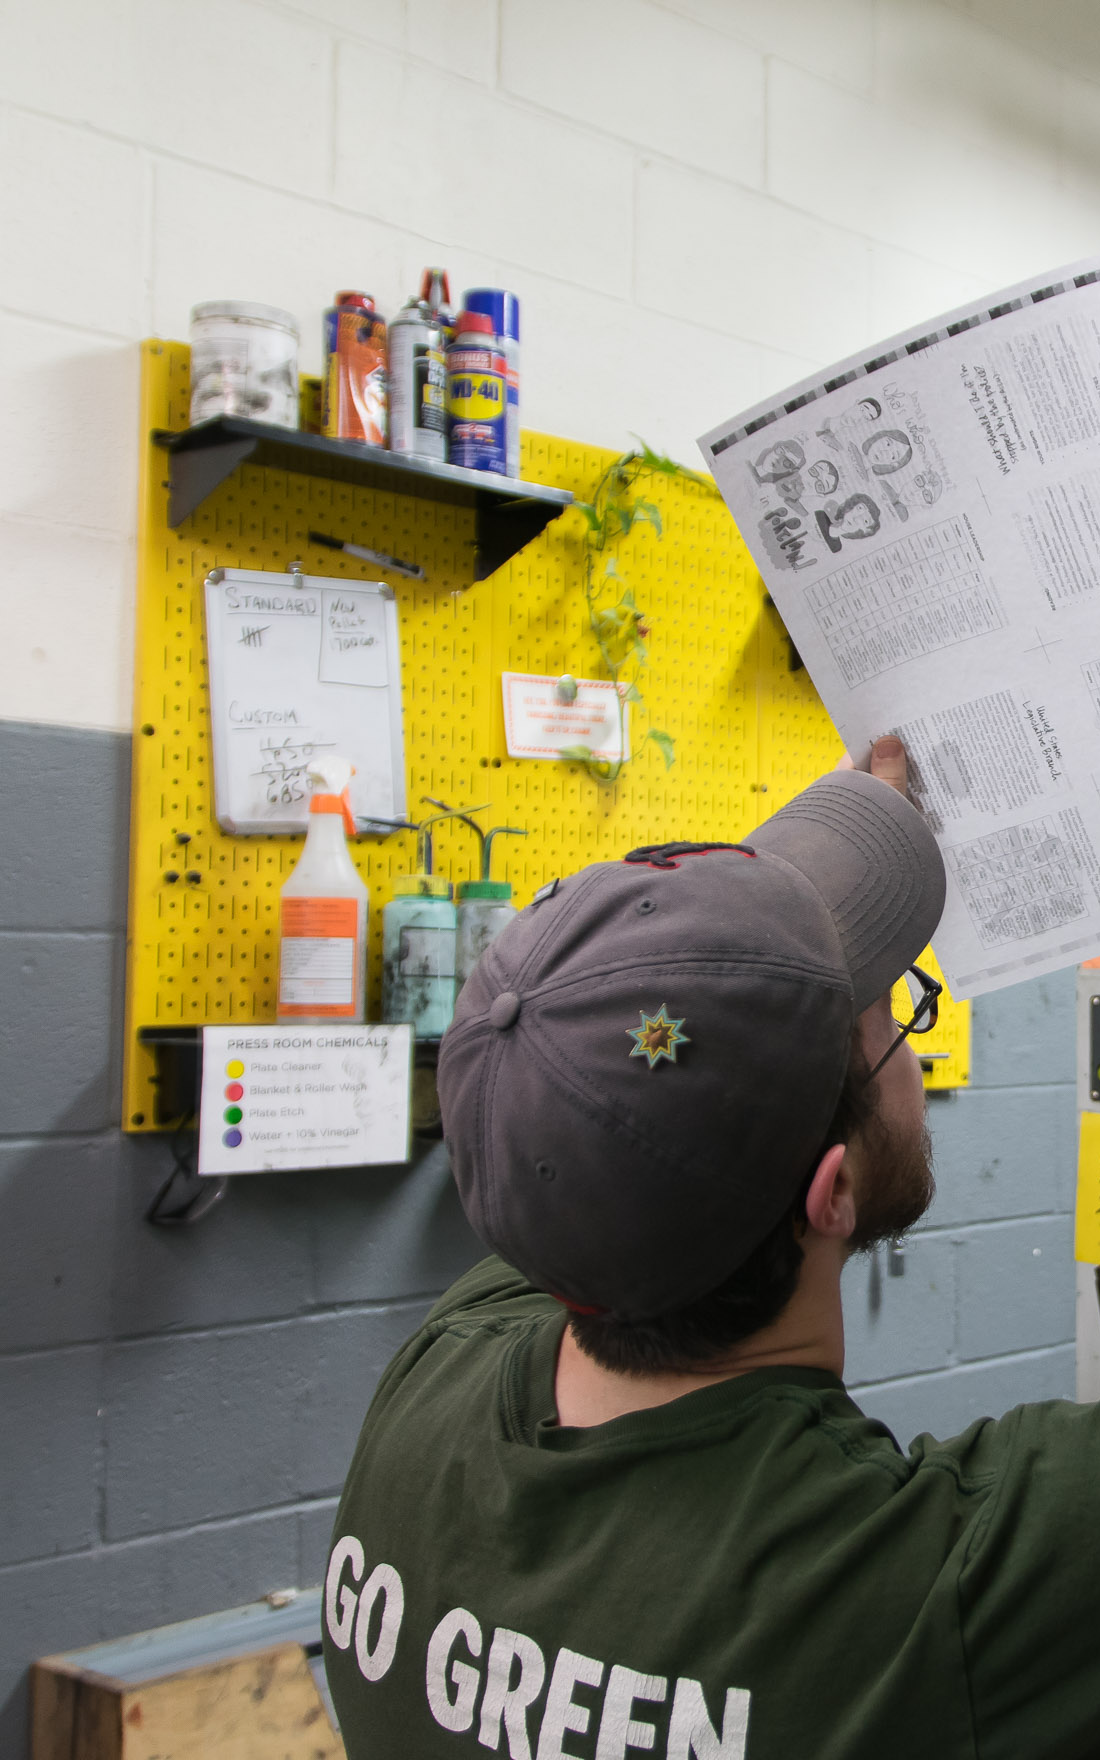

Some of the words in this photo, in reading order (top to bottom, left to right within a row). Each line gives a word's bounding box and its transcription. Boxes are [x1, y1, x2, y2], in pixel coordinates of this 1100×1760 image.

[450, 378, 500, 402] WD-40
[973, 366, 996, 398] police?
[968, 391, 981, 404] do
[987, 398, 999, 417] the
[978, 414, 999, 447] should
[995, 415, 1007, 432] by
[998, 431, 1019, 465] stopped
[991, 448, 1011, 476] What
[225, 586, 317, 615] STANDARD
[229, 700, 298, 725] CUSTOM
[1022, 700, 1047, 748] Legislative
[1041, 747, 1062, 782] Branch
[1036, 705, 1055, 735] United
[1049, 735, 1063, 760] States
[227, 1038, 269, 1050] PRESS
[273, 1038, 312, 1049] ROOM
[316, 1036, 388, 1048] CHEMICALS
[250, 1062, 278, 1073] Plate
[281, 1061, 323, 1072] Cleaner
[249, 1085, 290, 1096] Blanket
[305, 1083, 335, 1093] Roller
[339, 1082, 368, 1093] Wash
[249, 1108, 277, 1119] Plate
[280, 1106, 305, 1117] Etch
[249, 1130, 281, 1141] Water
[296, 1128, 316, 1139] 10%
[320, 1127, 361, 1140] Vinegar
[325, 1535, 405, 1682] GO
[426, 1606, 751, 1760] GREEN
